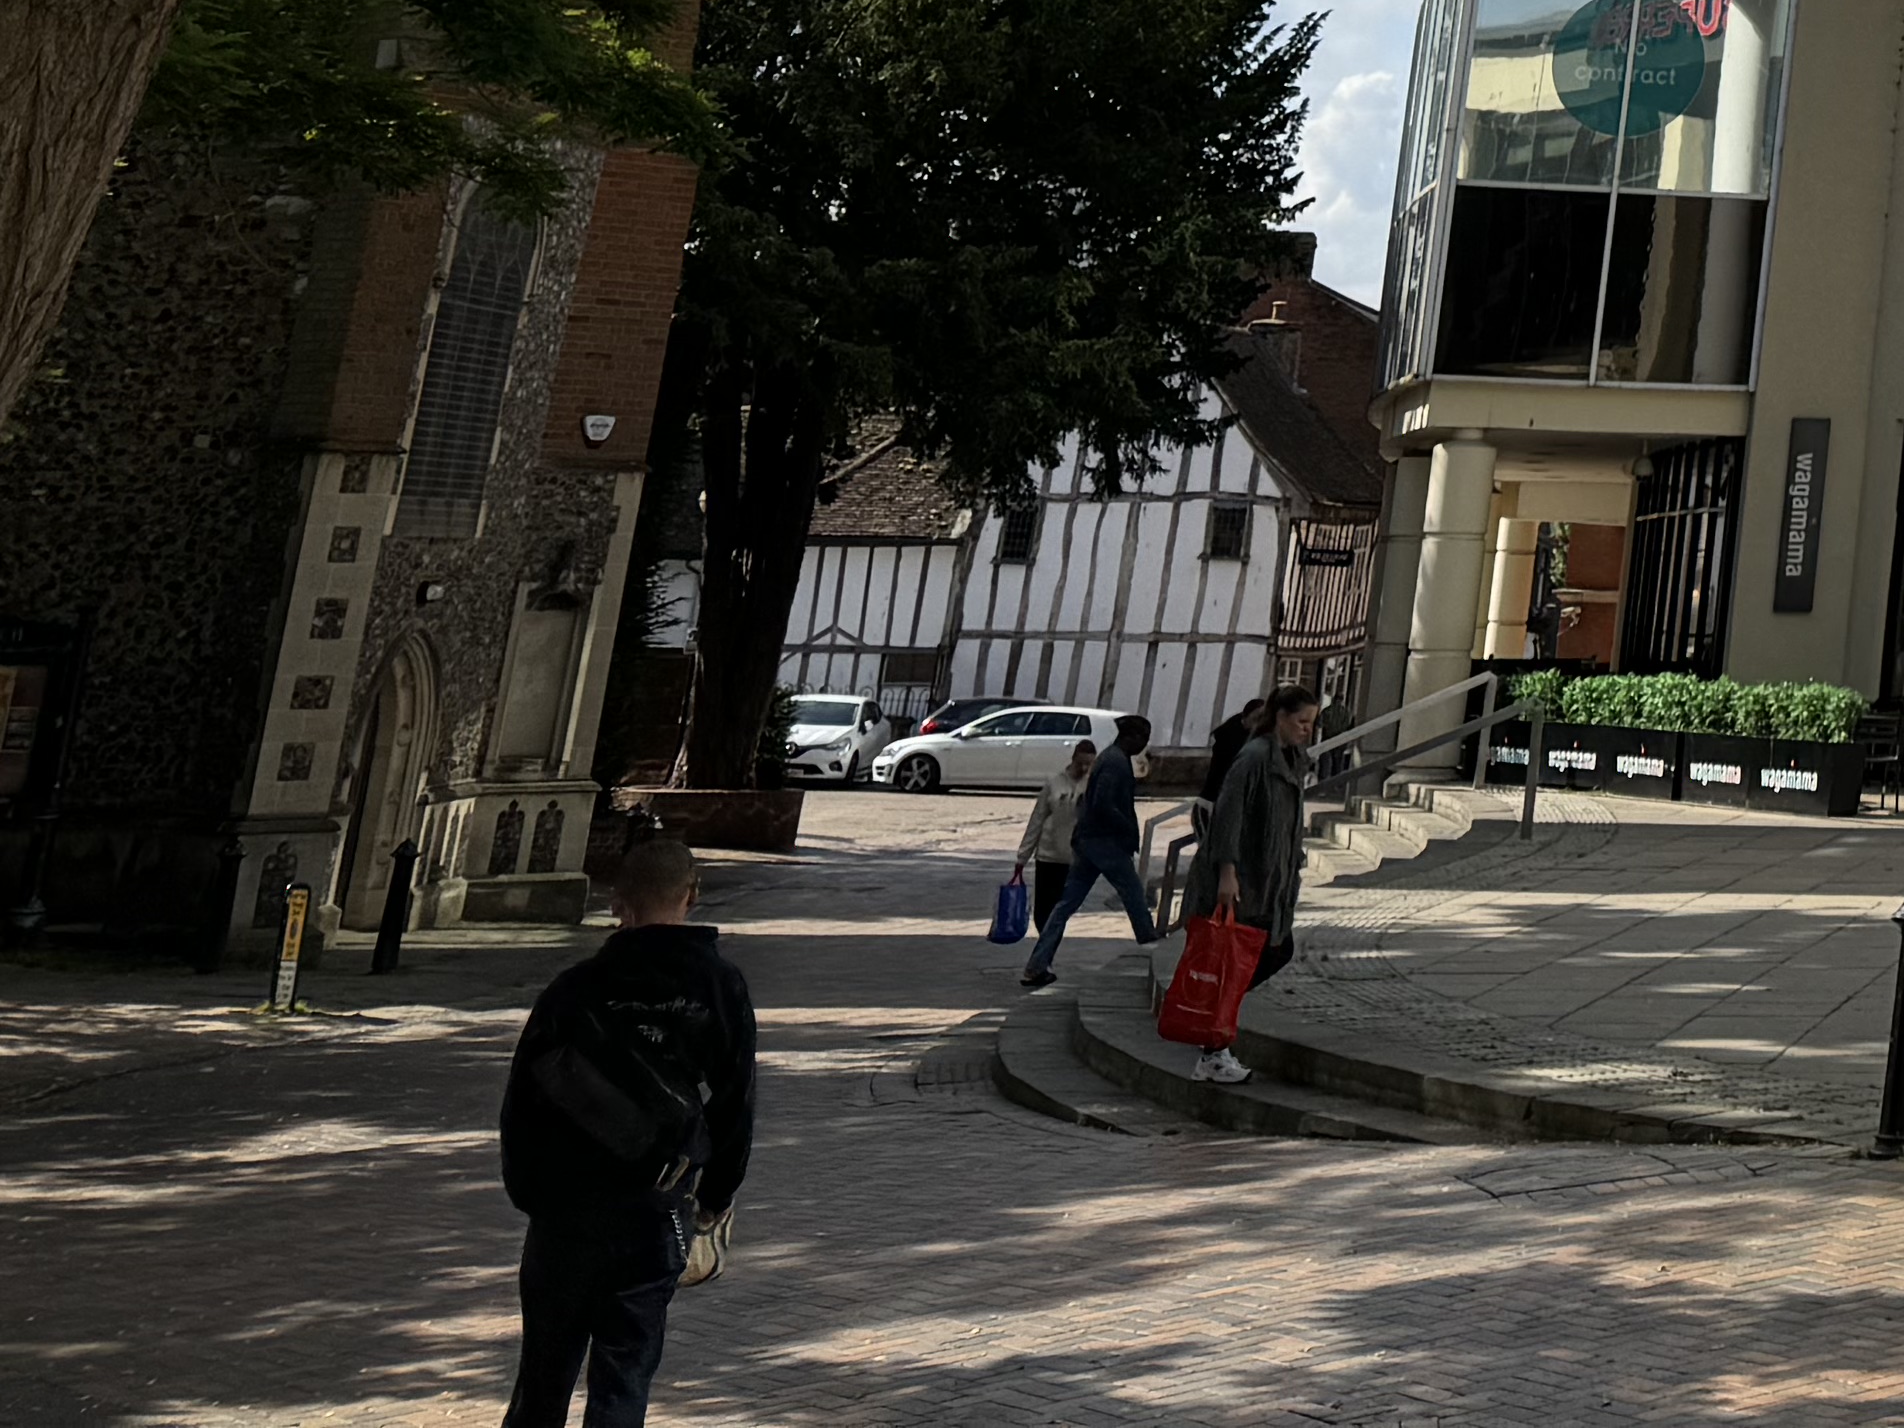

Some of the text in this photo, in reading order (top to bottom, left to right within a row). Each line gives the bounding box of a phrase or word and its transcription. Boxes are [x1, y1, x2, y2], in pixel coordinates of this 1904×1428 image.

[1785, 452, 1814, 577] wagamama
[1689, 761, 1742, 787] wagamama
[1760, 767, 1819, 794] wagamama
